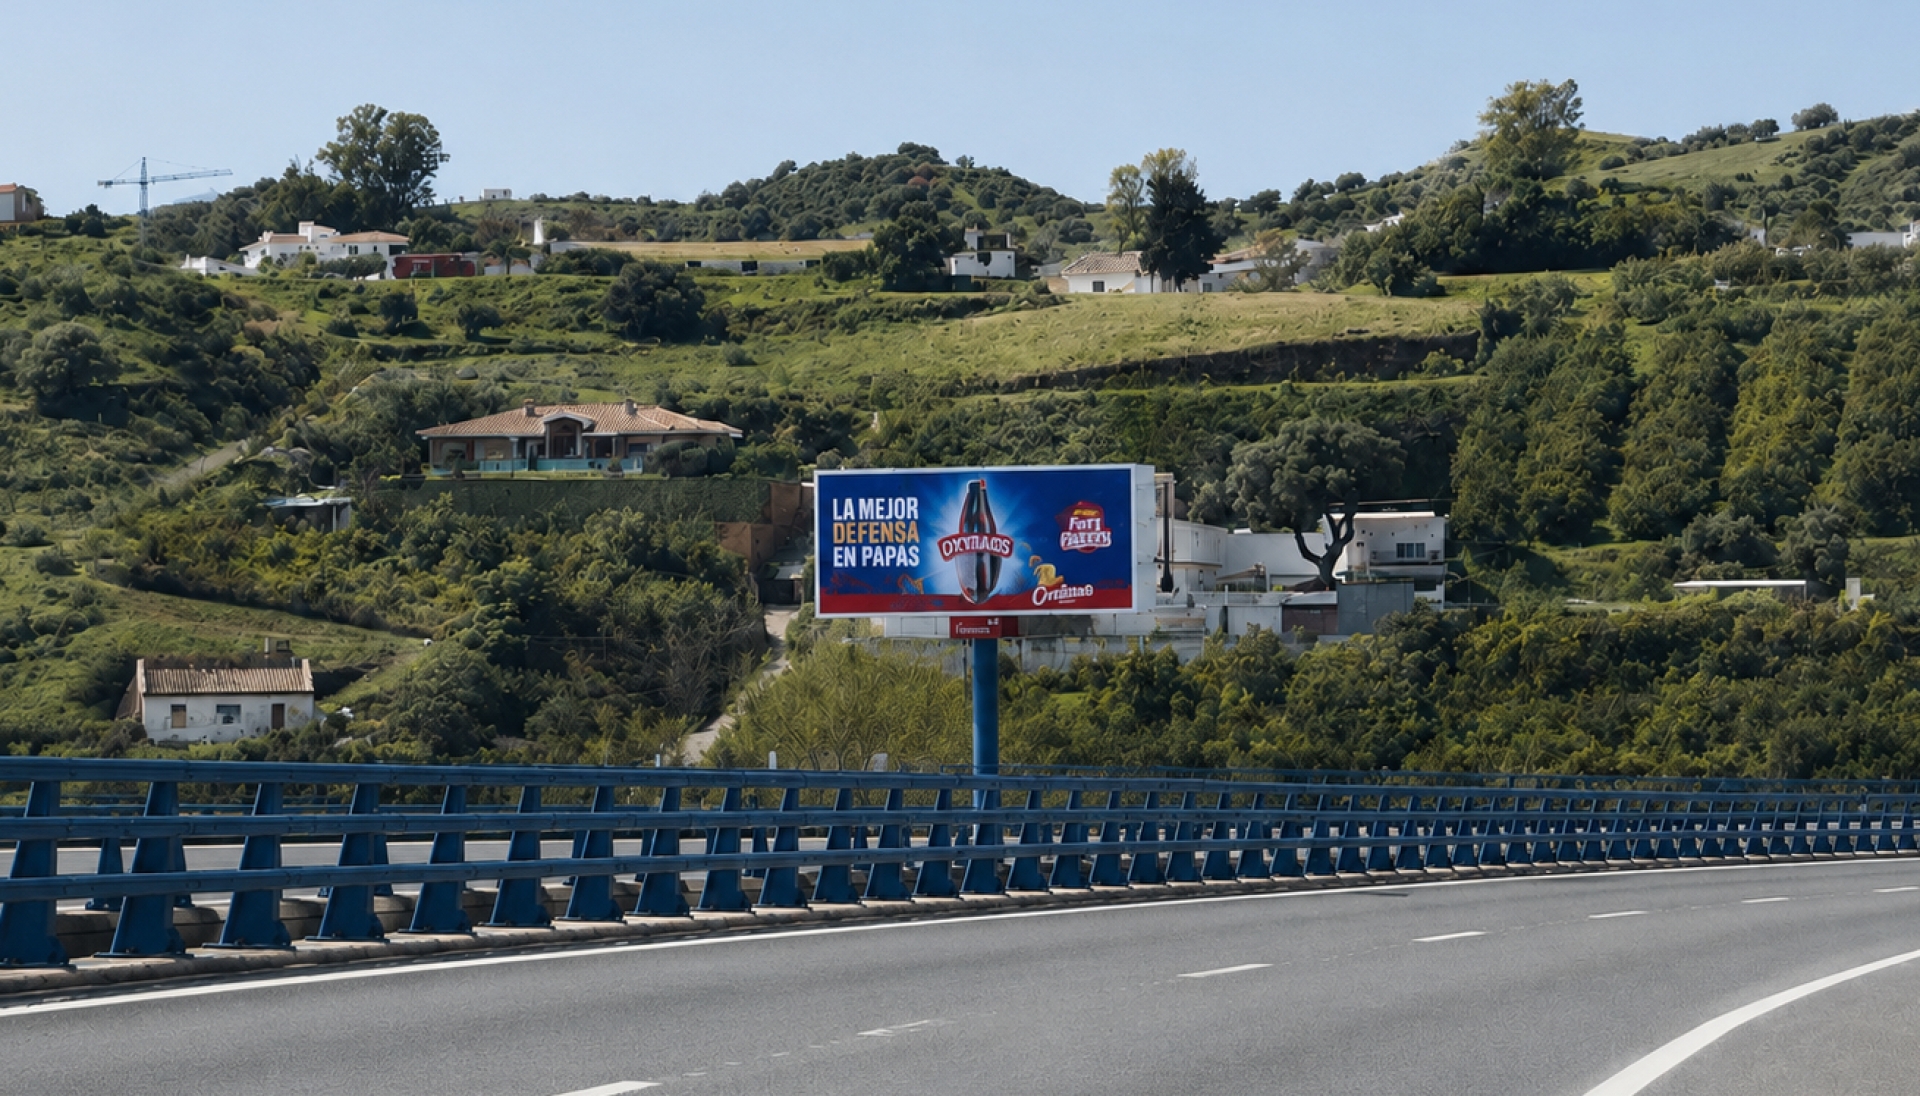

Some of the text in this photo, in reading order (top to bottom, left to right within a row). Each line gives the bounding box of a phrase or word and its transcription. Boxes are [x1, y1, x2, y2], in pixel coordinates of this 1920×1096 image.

[833, 497, 919, 520] LA MEJOR
[833, 520, 920, 544] DEFENSA
[833, 545, 920, 567] EN PAPAS
